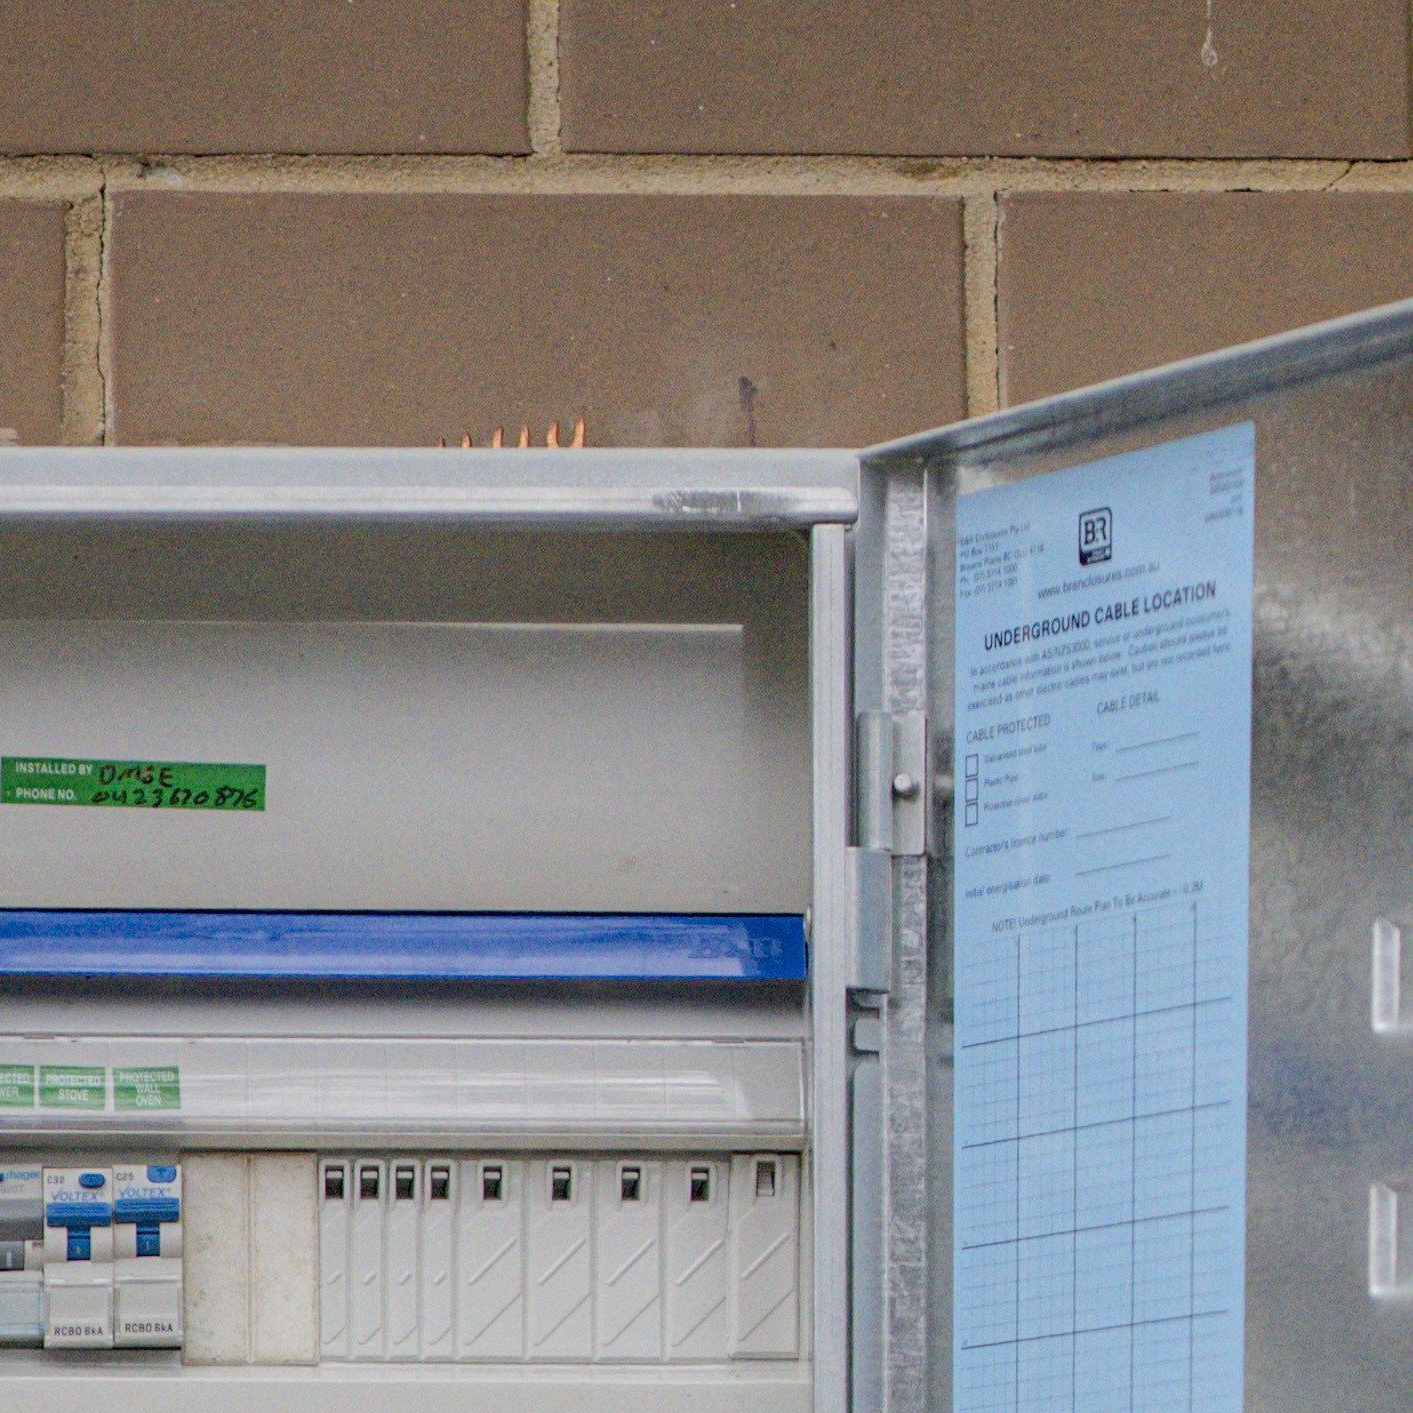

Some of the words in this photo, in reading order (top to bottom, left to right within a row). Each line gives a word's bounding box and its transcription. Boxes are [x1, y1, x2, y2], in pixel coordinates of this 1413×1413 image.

[984, 611, 1090, 650] UNDERGROUND
[1095, 599, 1139, 624] CABLE
[1144, 581, 1216, 613] LOCATION
[967, 726, 995, 744] CABLE
[997, 713, 1051, 737] PROTECTED
[16, 762, 76, 774] INSTALLED
[79, 764, 93, 775] BY
[16, 788, 55, 799] PHONE
[45, 1074, 101, 1086] PROTECTED
[120, 1071, 175, 1082] PROTECTED
[58, 1088, 89, 1101] STOVE
[135, 1095, 161, 1106] OVEN
[116, 1172, 134, 1181] C25
[55, 1326, 82, 1336] RCBO
[125, 1322, 152, 1333] RCBO
